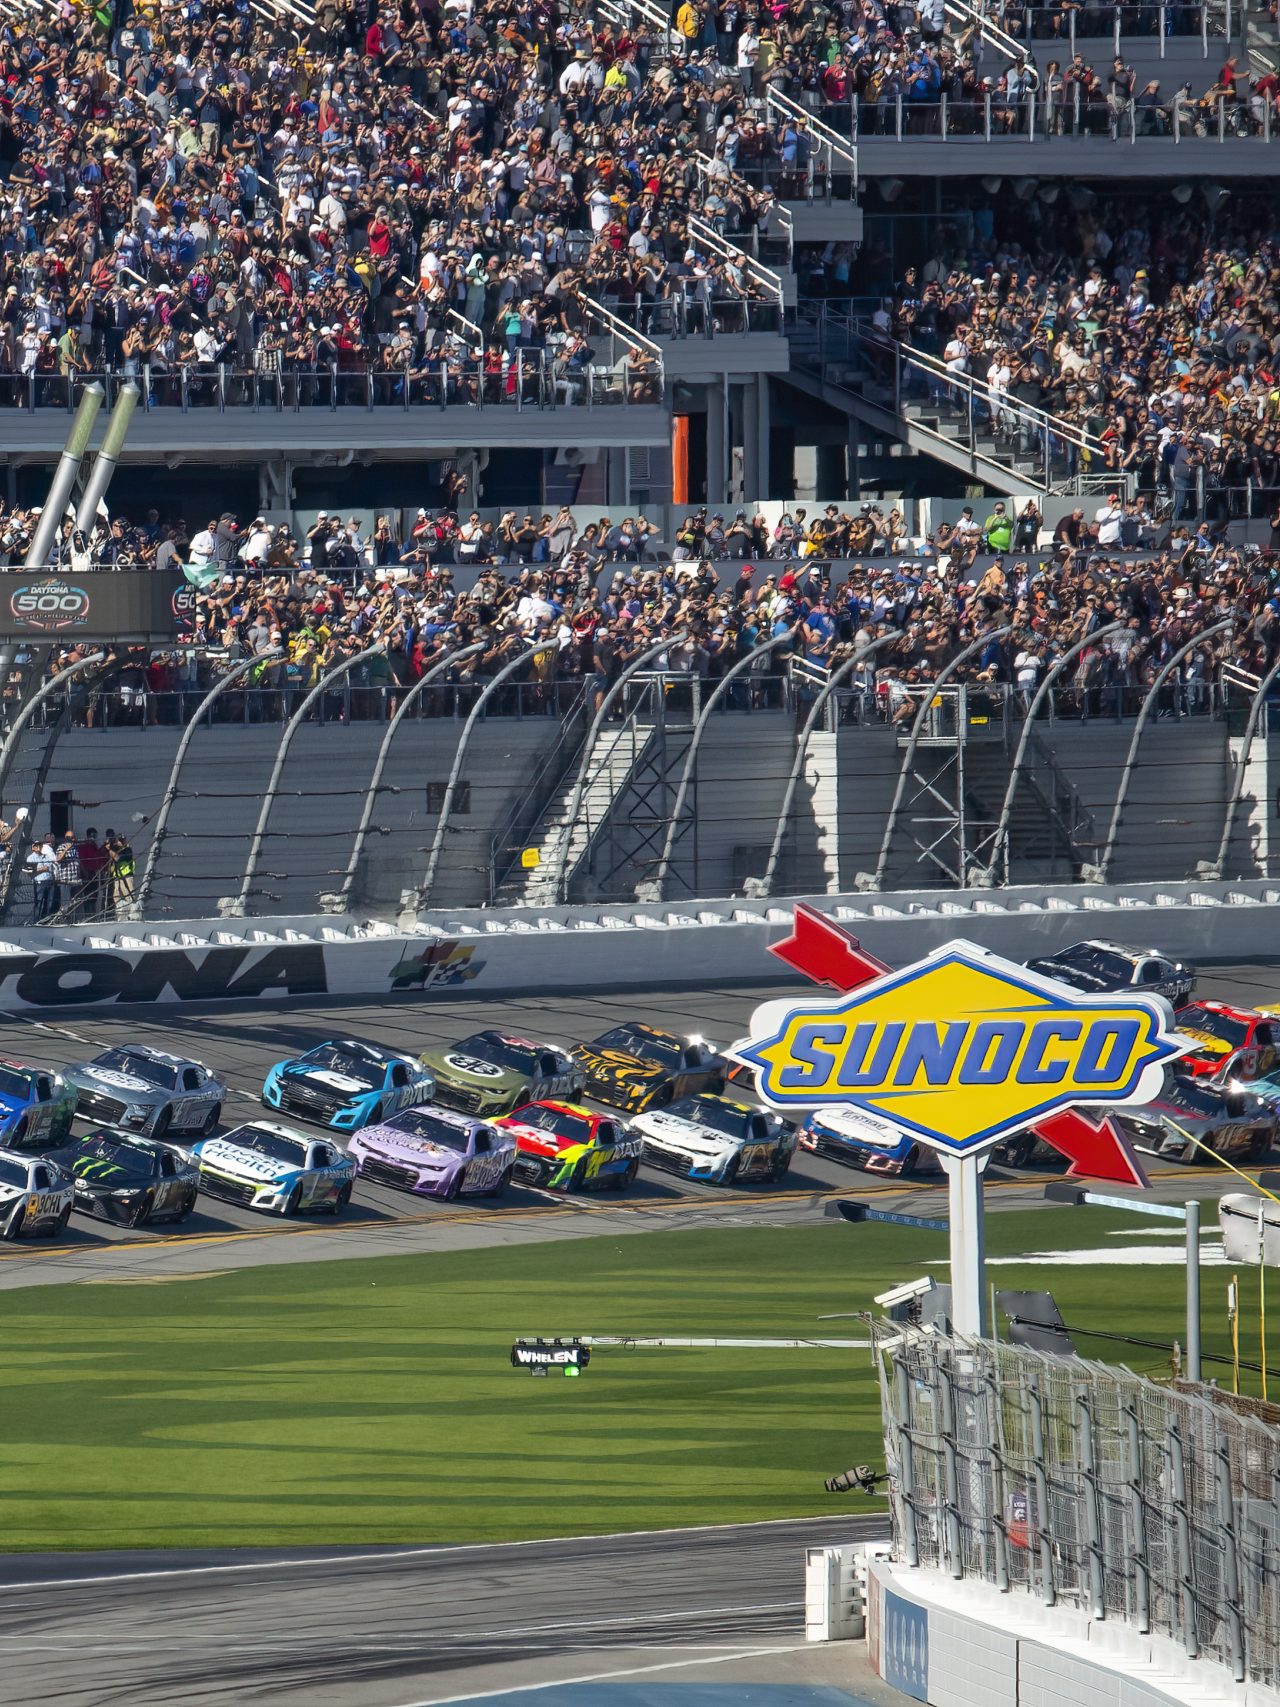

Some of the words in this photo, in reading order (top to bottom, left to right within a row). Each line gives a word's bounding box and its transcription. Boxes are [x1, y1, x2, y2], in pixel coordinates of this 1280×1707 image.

[30, 586, 69, 594] DAYTONA
[18, 595, 82, 611] 500
[779, 1019, 1139, 1087] SUNOCO
[517, 1350, 579, 1363] WHELEN
